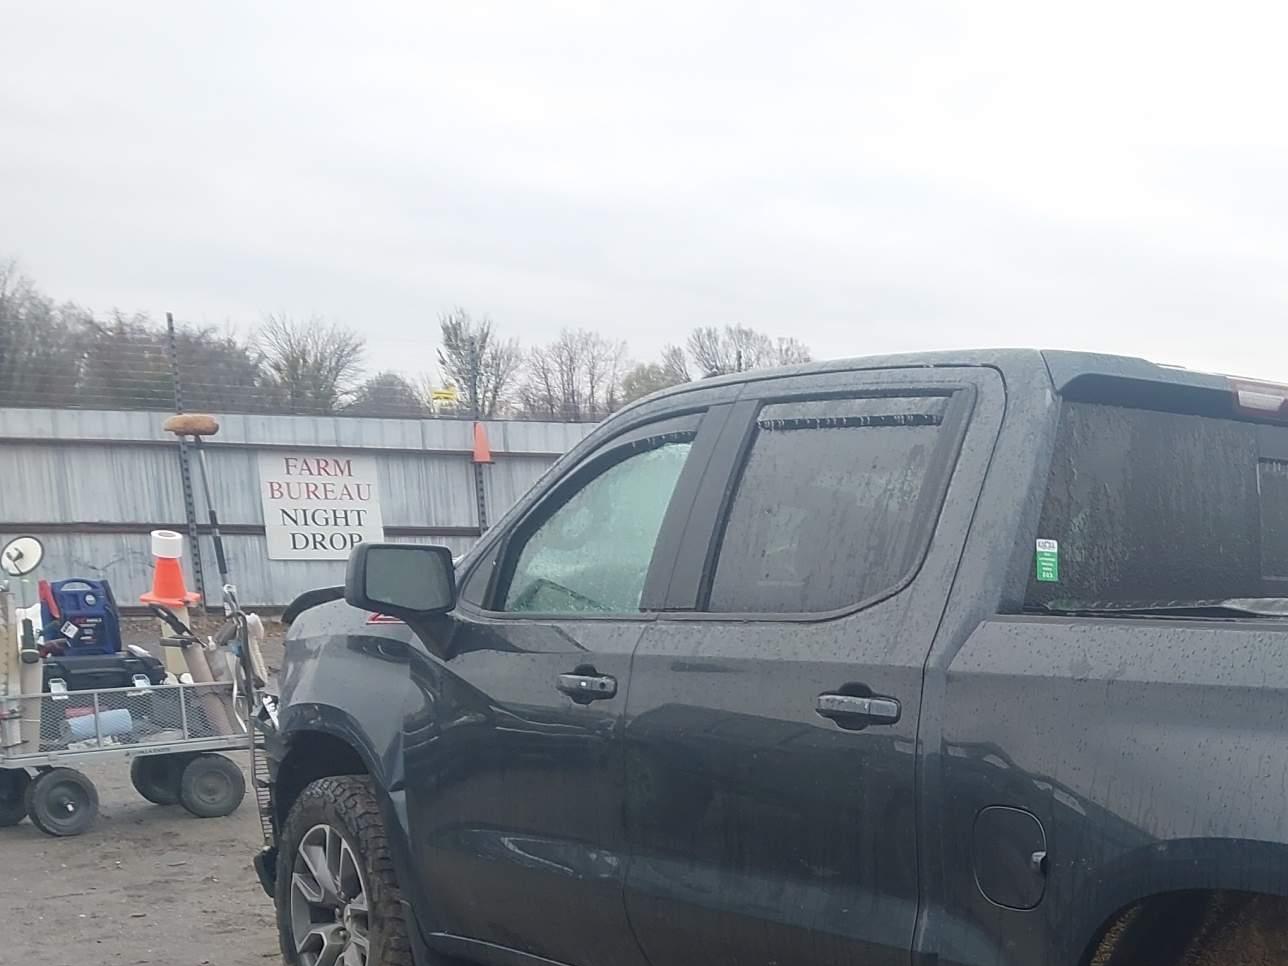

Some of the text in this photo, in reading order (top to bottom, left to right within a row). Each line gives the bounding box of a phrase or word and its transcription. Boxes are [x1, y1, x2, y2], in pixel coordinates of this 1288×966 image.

[284, 457, 353, 477] FARM
[267, 481, 372, 501] BUREAU
[280, 508, 367, 526] NIGHT
[290, 532, 363, 550] DROP
